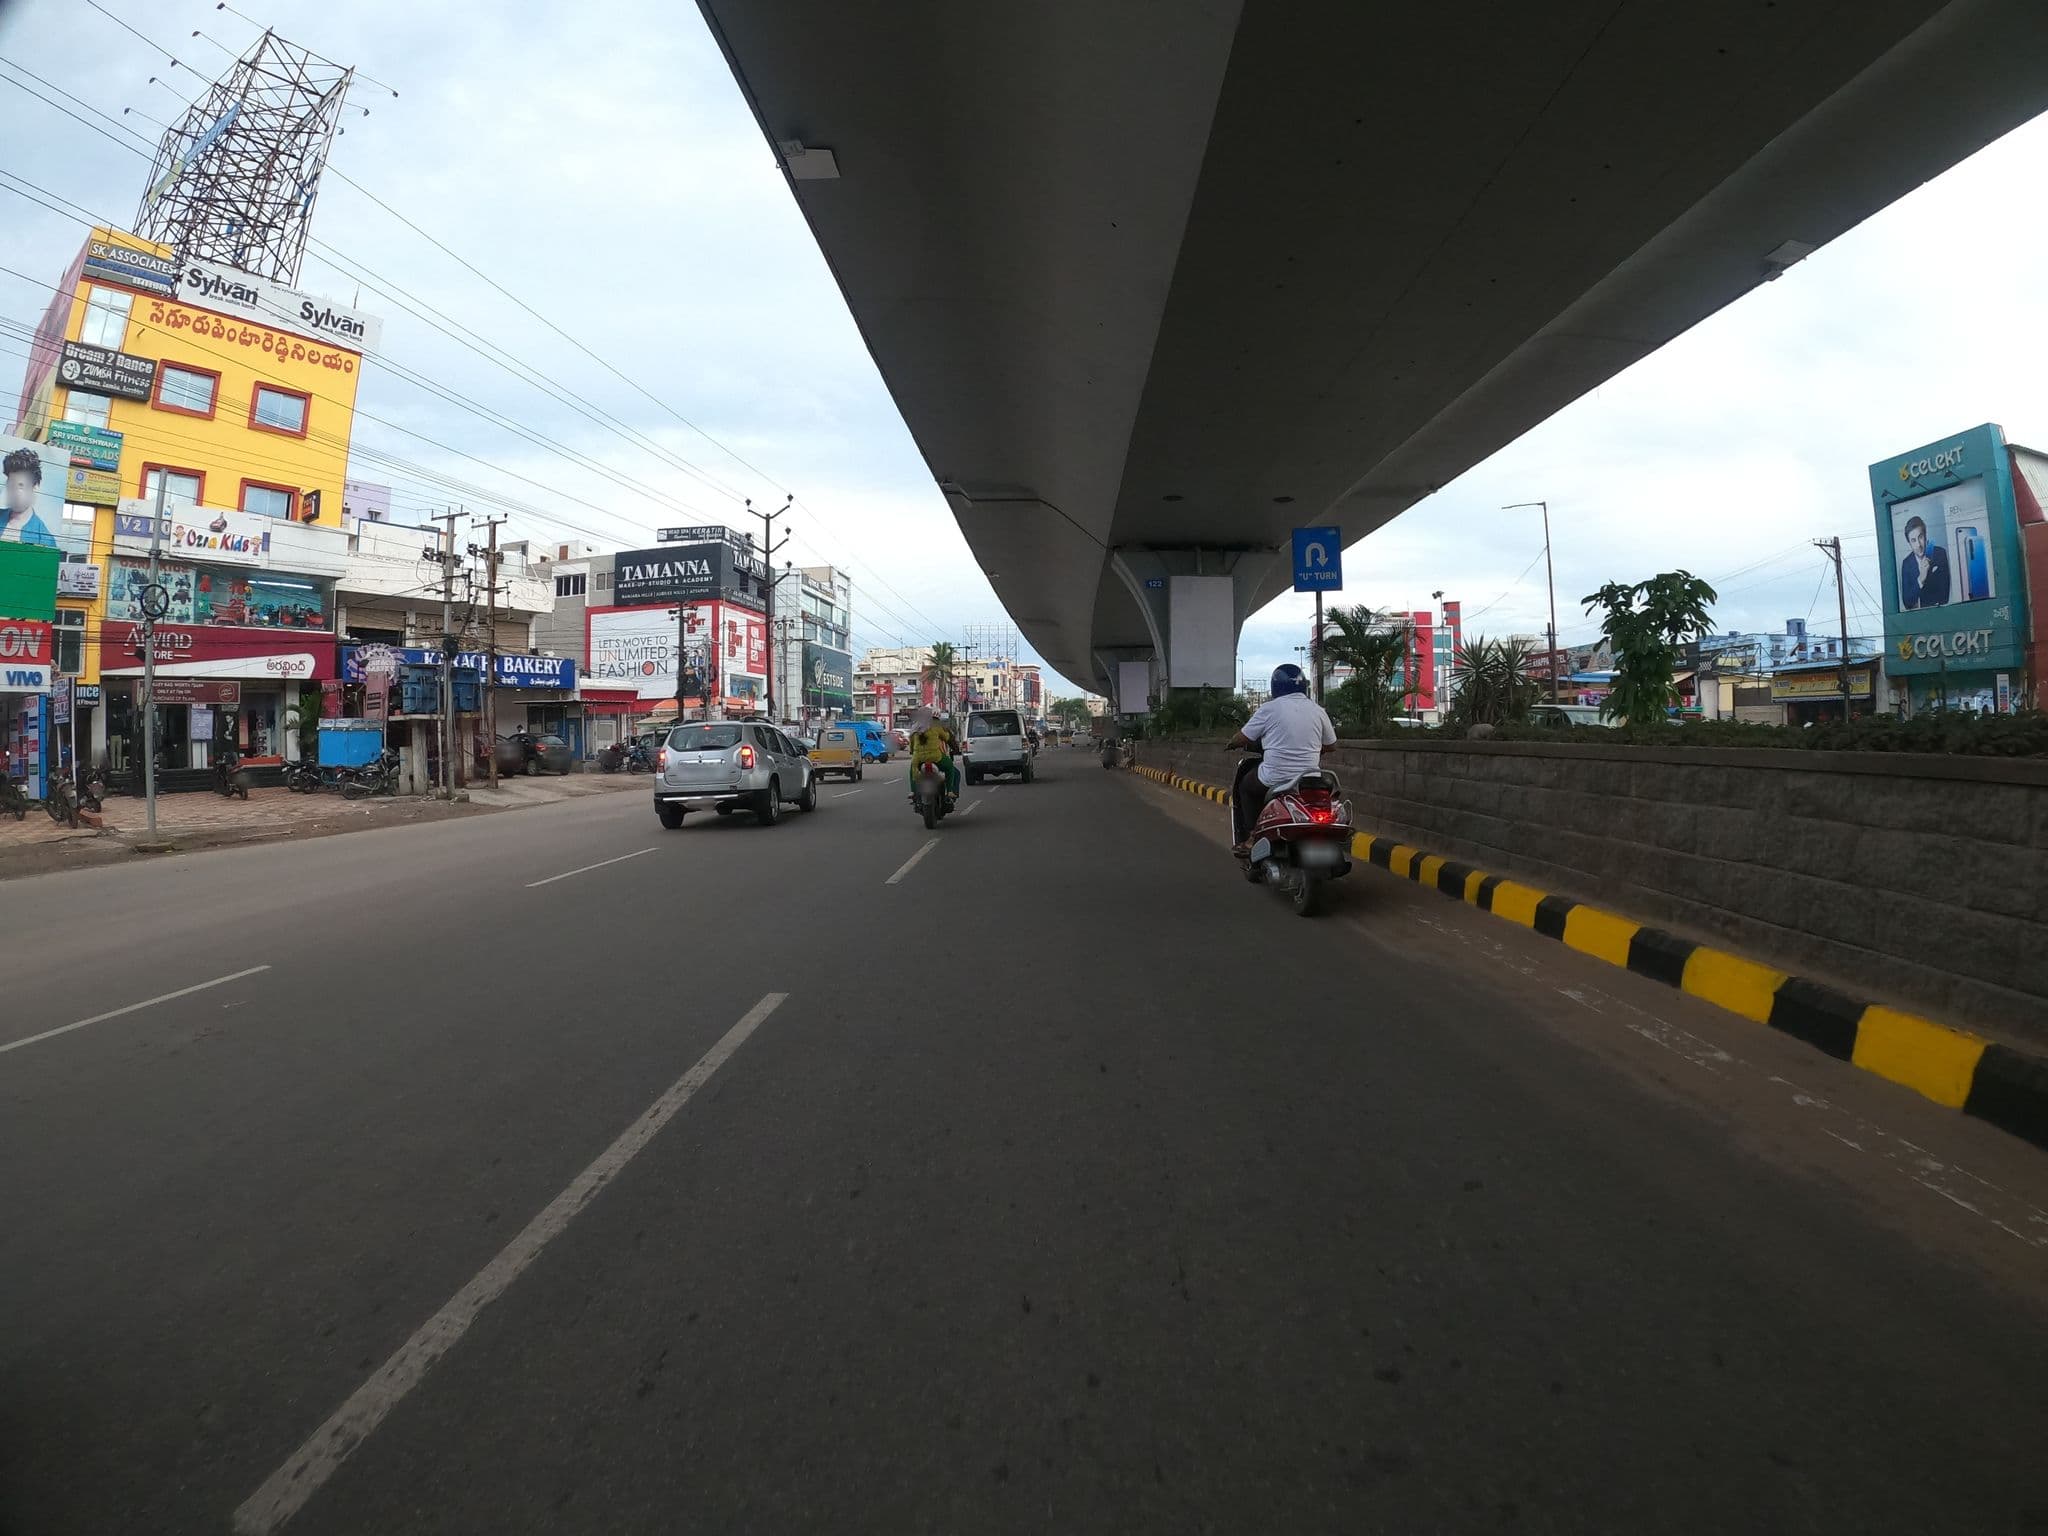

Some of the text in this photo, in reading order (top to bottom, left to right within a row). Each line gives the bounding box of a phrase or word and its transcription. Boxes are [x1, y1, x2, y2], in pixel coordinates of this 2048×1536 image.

[92, 244, 107, 256] SK
[108, 248, 176, 274] ASSOCIATES
[106, 352, 115, 365] 2
[116, 354, 153, 373] Dance
[67, 434, 118, 449] VIGNESHWARA
[219, 534, 249, 552] Kids
[622, 559, 712, 581] TAMANNA
[1314, 571, 1337, 580] TURN
[599, 635, 668, 649] LET'S MOVE TO
[599, 646, 668, 662] UNLIMITED
[504, 657, 563, 675] BAKERY
[598, 660, 668, 678] FASHION
